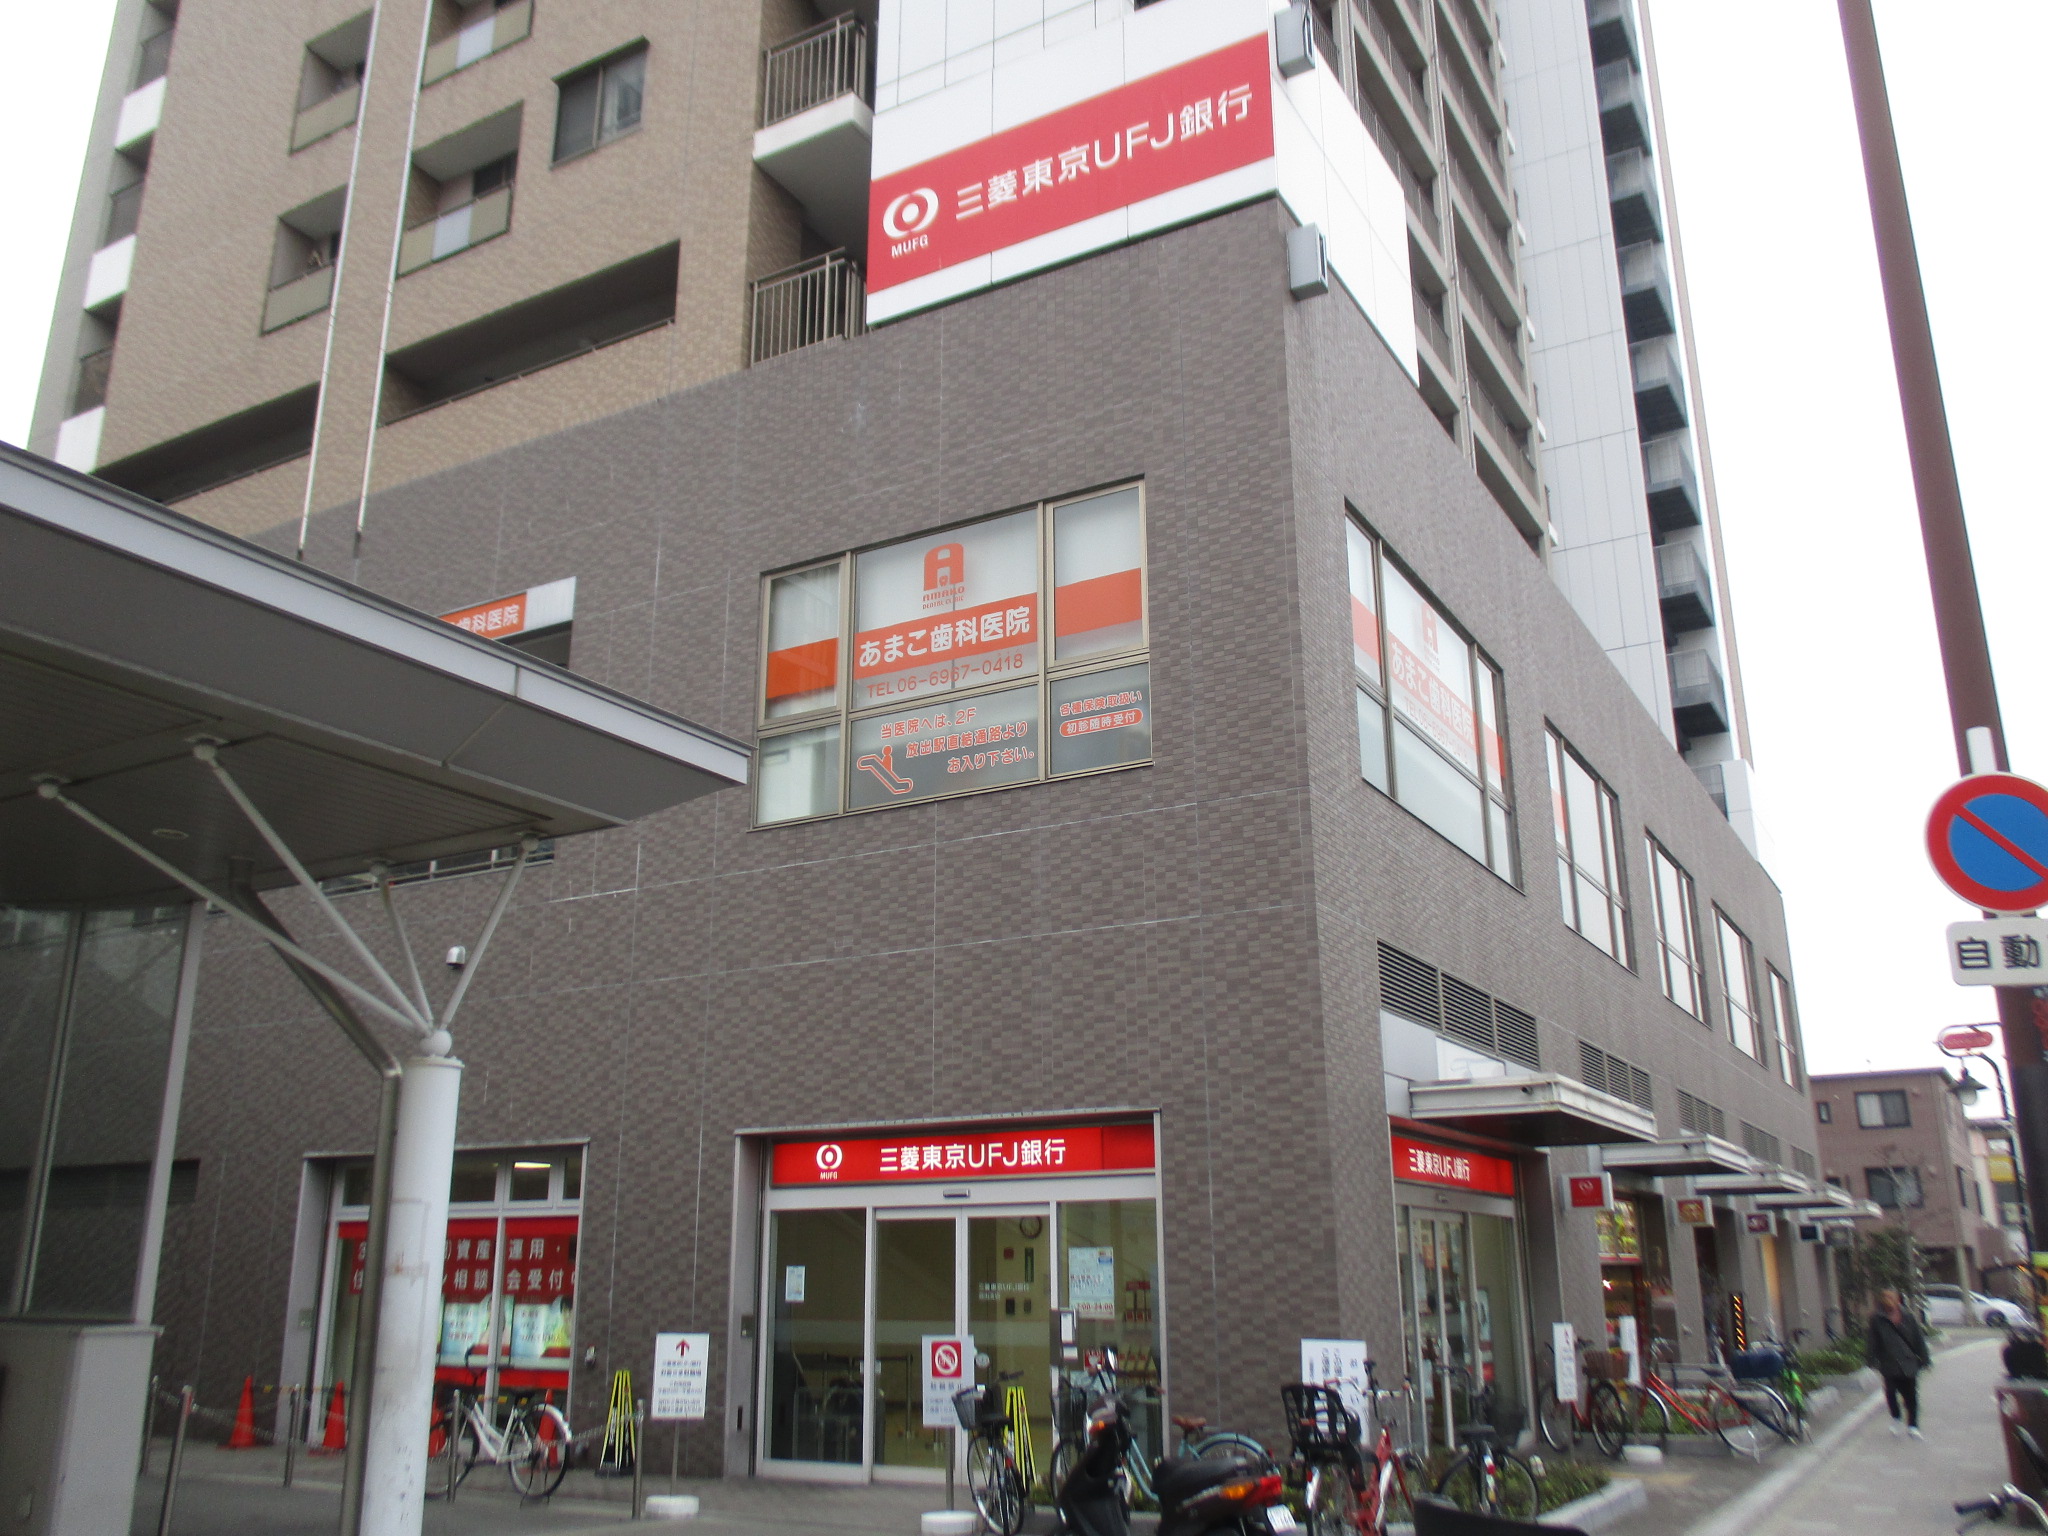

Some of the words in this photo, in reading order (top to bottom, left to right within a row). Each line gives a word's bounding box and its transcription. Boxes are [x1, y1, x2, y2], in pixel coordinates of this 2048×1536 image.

[954, 83, 1252, 220] 三菱東京UFJ銀行
[891, 234, 929, 258] MUFG
[450, 604, 520, 633] 歯科医院
[859, 606, 1029, 668] あまこ歯科医院
[867, 682, 895, 699] TEL
[897, 653, 1023, 692] 06-6967-0418
[1390, 641, 1474, 746] あまこ歯科医院
[880, 707, 977, 739] 当医院へは、2F
[1066, 711, 1136, 734] 初診随時受付
[906, 721, 1028, 758] 放出駅直結通路より
[947, 746, 1035, 773] お入り下さい。
[1956, 933, 2048, 969] 自動
[879, 1138, 1066, 1172] 三菱東京UFJ銀行
[1408, 1148, 1470, 1181] 三菱東京UFJ銀行
[819, 1171, 838, 1180] MUFG
